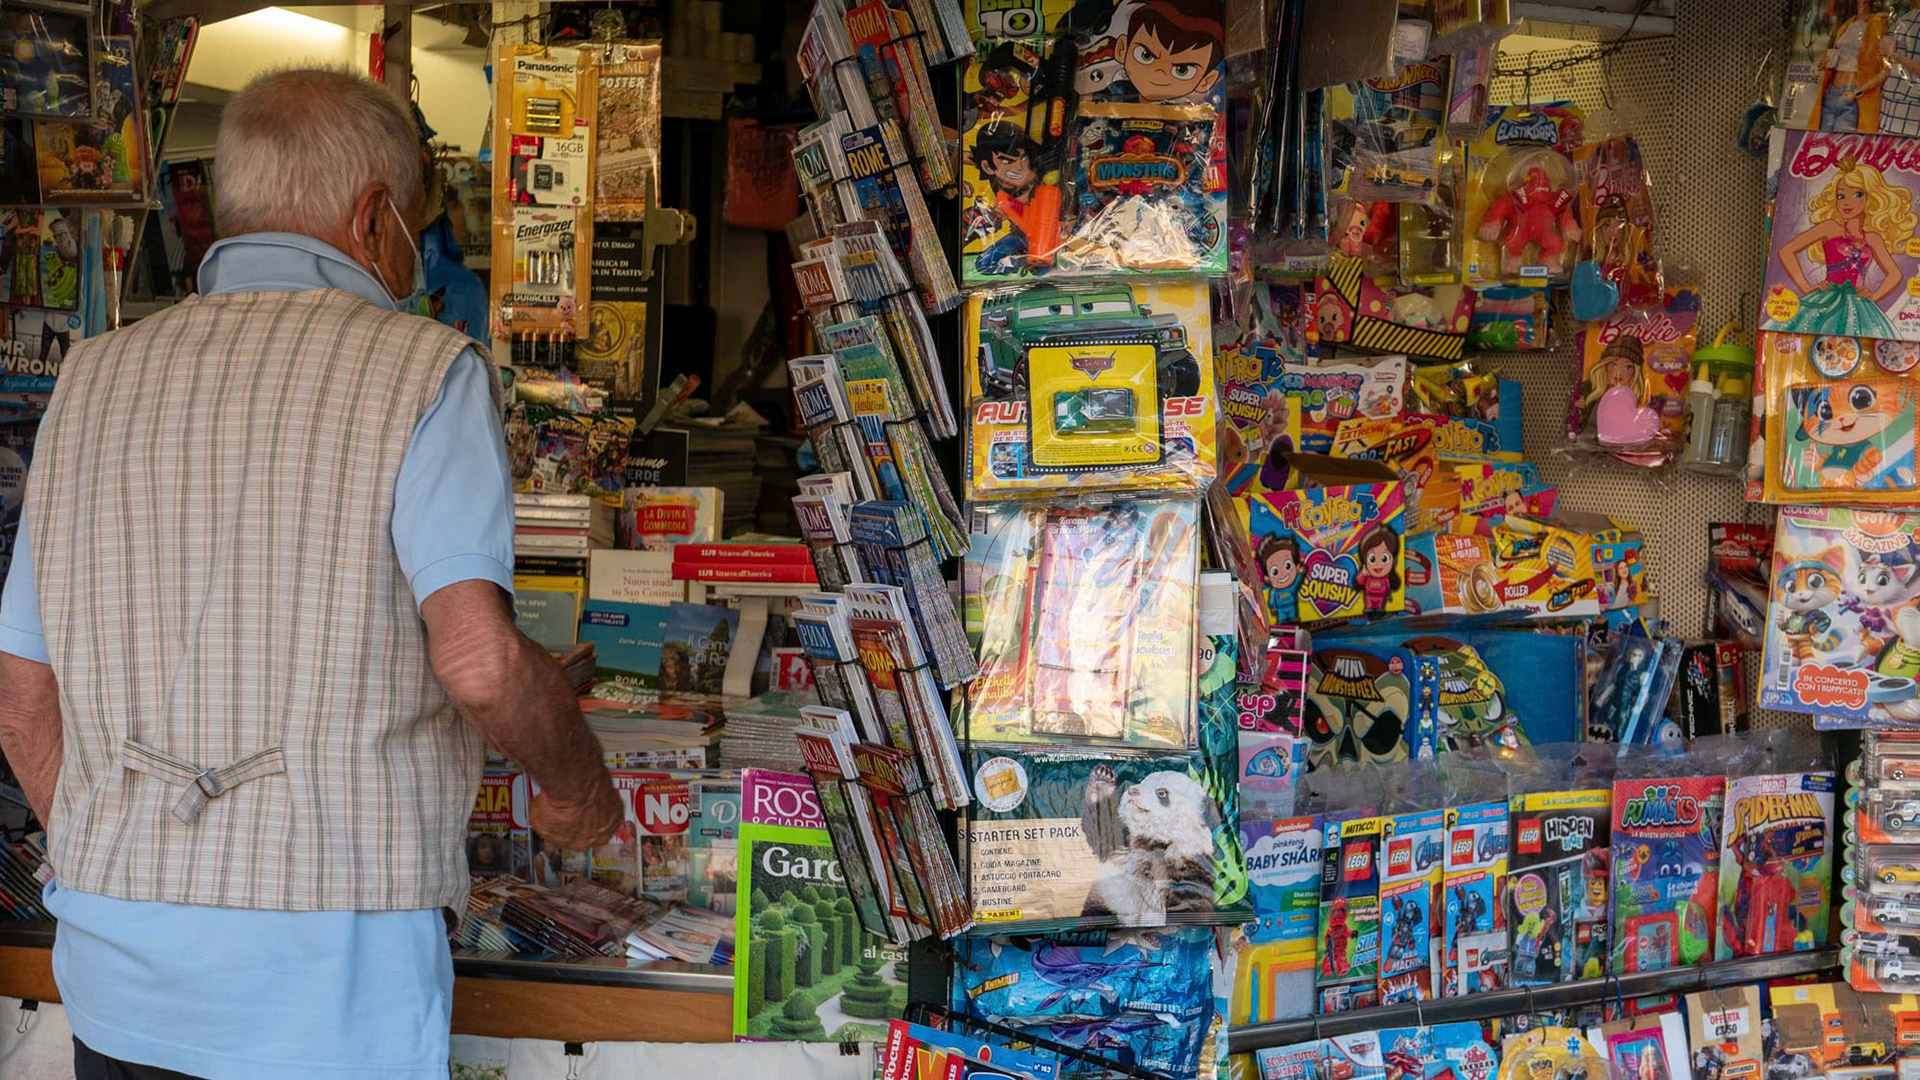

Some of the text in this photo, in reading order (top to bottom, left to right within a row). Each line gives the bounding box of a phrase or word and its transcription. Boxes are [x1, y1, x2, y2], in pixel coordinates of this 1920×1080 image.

[851, 7, 885, 42] ROMA
[981, 9, 1036, 37] 10
[518, 60, 575, 73] Panasonic
[601, 77, 646, 88] POSTER
[556, 142, 585, 153] 16GB
[848, 143, 890, 180] ROME
[1098, 162, 1177, 179] MONSTERS
[517, 219, 574, 239] Energizer
[592, 260, 619, 268] ASILICA
[612, 268, 655, 277] TRASTEVE
[797, 270, 832, 296] ROMA
[1899, 311, 1920, 320] DREA
[1599, 314, 1681, 343] Barbie
[0, 339, 25, 356] MR
[2, 355, 62, 377] WRON
[800, 385, 833, 417] ROME
[1229, 388, 1260, 407] SUPER
[1384, 434, 1418, 462] FAST
[656, 508, 687, 520] DIVINA
[1784, 505, 1824, 516] COLORA
[1844, 530, 1909, 552] MAGAZINE
[623, 576, 674, 587] Nuovi studi
[1311, 563, 1349, 585] SUPER
[624, 588, 639, 596] San
[642, 587, 684, 597] Cosimato
[1301, 580, 1359, 605] SQUISHY
[1504, 585, 1529, 599] ROLLER
[800, 624, 832, 649] РИМ
[860, 649, 895, 672] ROMA
[1335, 658, 1366, 678] MINI
[615, 675, 645, 686] ROMA
[1444, 680, 1470, 693] MINI
[1814, 676, 1858, 686] CONCERTO
[1687, 689, 1696, 740] TECHNIC
[801, 740, 837, 767] ROMA
[1762, 780, 1785, 792] MARVEL
[754, 784, 822, 819] ROS
[1622, 797, 1697, 826] PJ MASKS
[1344, 821, 1376, 835] MITICO!
[1546, 817, 1593, 840] HIDDEN
[1727, 793, 1826, 848] SPIDER-MAN
[970, 826, 1079, 843] STARTER SET PACK
[1520, 830, 1539, 843] LEGO
[1563, 833, 1583, 849] SIDE
[980, 848, 1014, 856] CONTIENE:
[1273, 839, 1305, 851] pinkfong
[1453, 841, 1472, 854] LEGO
[981, 861, 1002, 869] GUIDA
[1004, 859, 1041, 867] MAGAZINE
[1246, 853, 1279, 871] BABY
[1346, 854, 1368, 869] LEGO
[1390, 850, 1409, 864] LEGO
[981, 873, 1017, 881] ASTUCCIO
[1019, 871, 1061, 879] PORTACARD
[982, 885, 1027, 893] GAMEBOARD
[982, 898, 1013, 906] BUSTINE
[987, 910, 1020, 918] PANINI
[863, 945, 910, 962] al cast
[1709, 1012, 1740, 1026] OFFERTA
[884, 1029, 902, 1080] Focus
[1294, 1050, 1318, 1062] TUTTO
[901, 1046, 914, 1080] ocus
